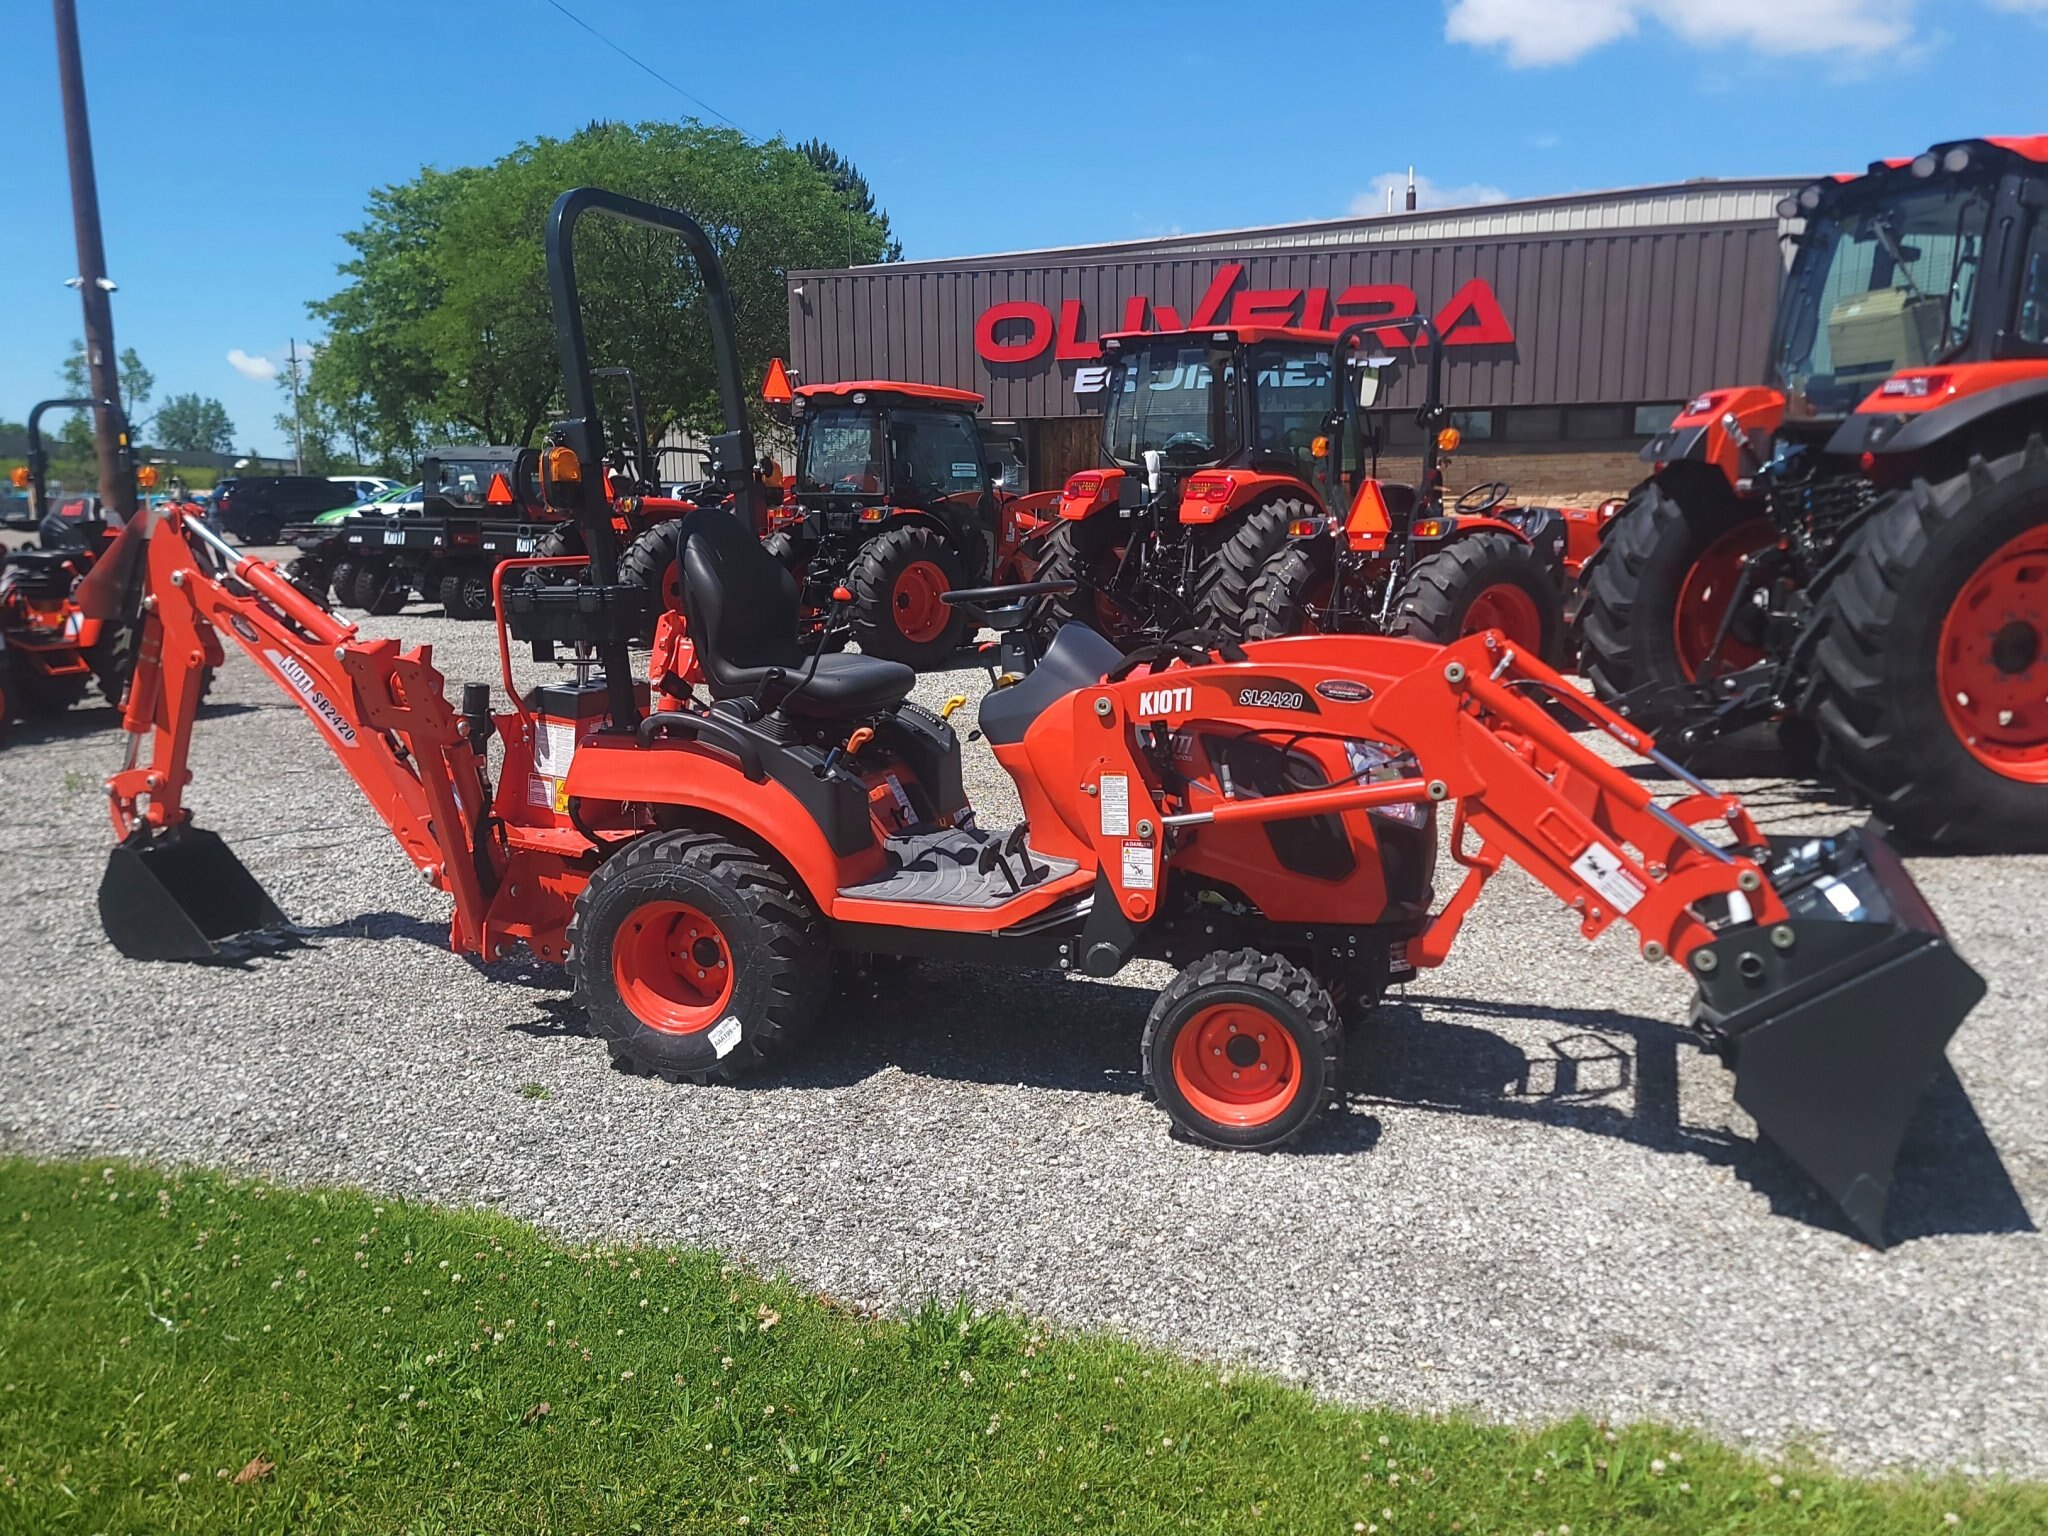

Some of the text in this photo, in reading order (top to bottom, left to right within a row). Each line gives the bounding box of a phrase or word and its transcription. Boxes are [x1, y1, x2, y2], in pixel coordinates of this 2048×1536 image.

[974, 263, 1516, 363] OLIVEIRA
[279, 655, 315, 694] KIOTI
[312, 691, 356, 741] SB2420
[1139, 687, 1192, 716] KIOTI
[1239, 688, 1304, 710] SL2420
